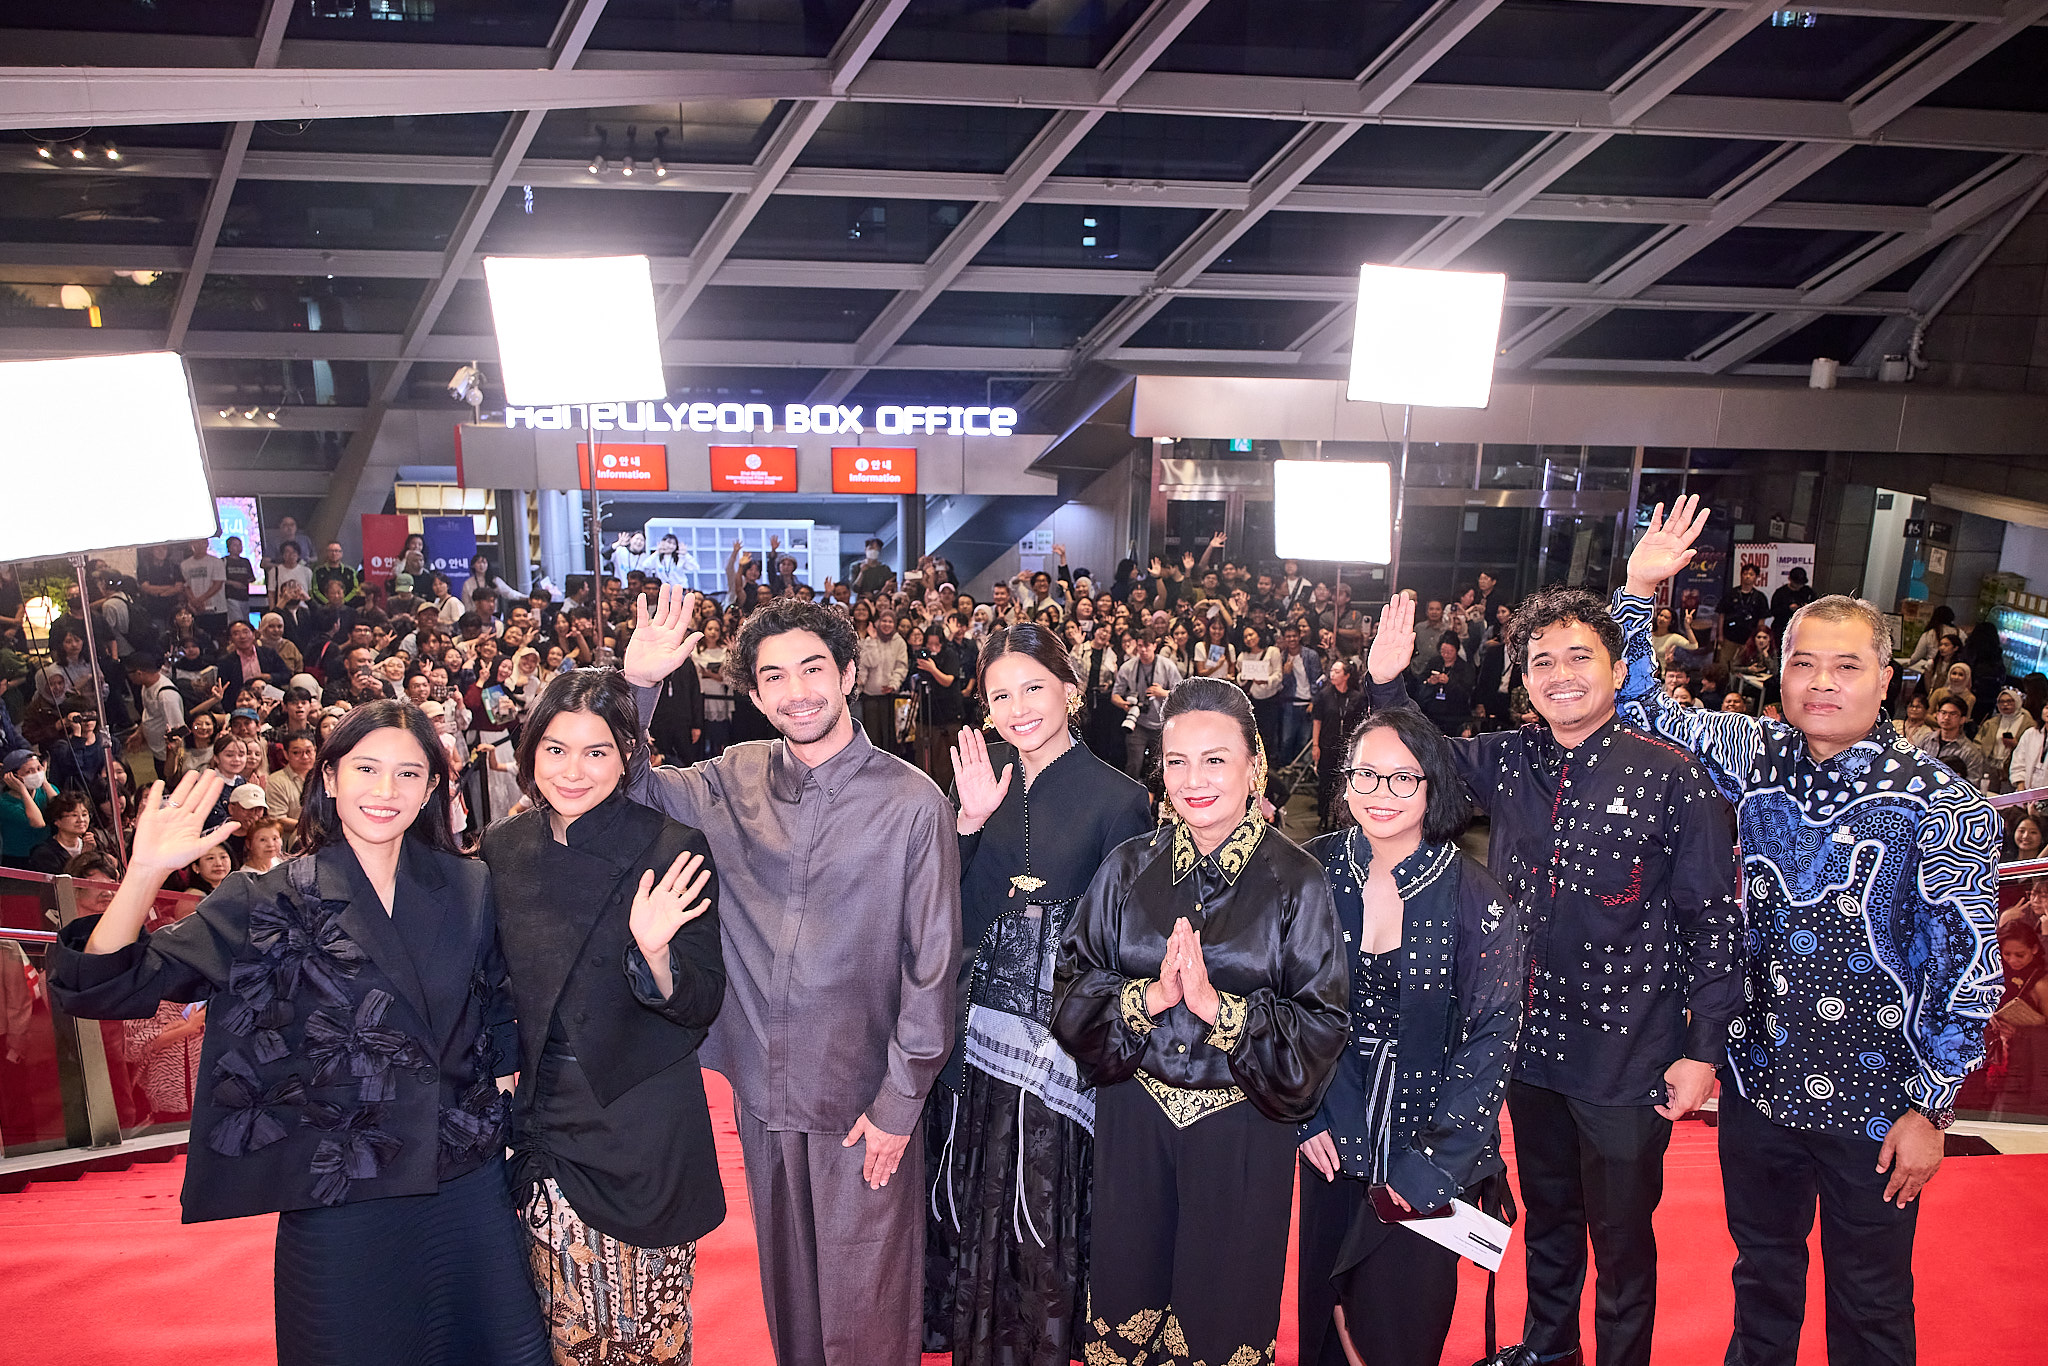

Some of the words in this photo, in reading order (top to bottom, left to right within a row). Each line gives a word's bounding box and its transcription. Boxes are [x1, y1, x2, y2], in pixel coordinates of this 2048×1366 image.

[785, 403, 865, 435] BOX
[619, 456, 641, 467] 안내
[870, 459, 892, 471] 안내
[596, 469, 651, 479] Information
[848, 473, 901, 483] Information
[448, 557, 469, 569] 안내
[1740, 553, 1769, 569] SAND
[1777, 556, 1814, 565] MPBELL
